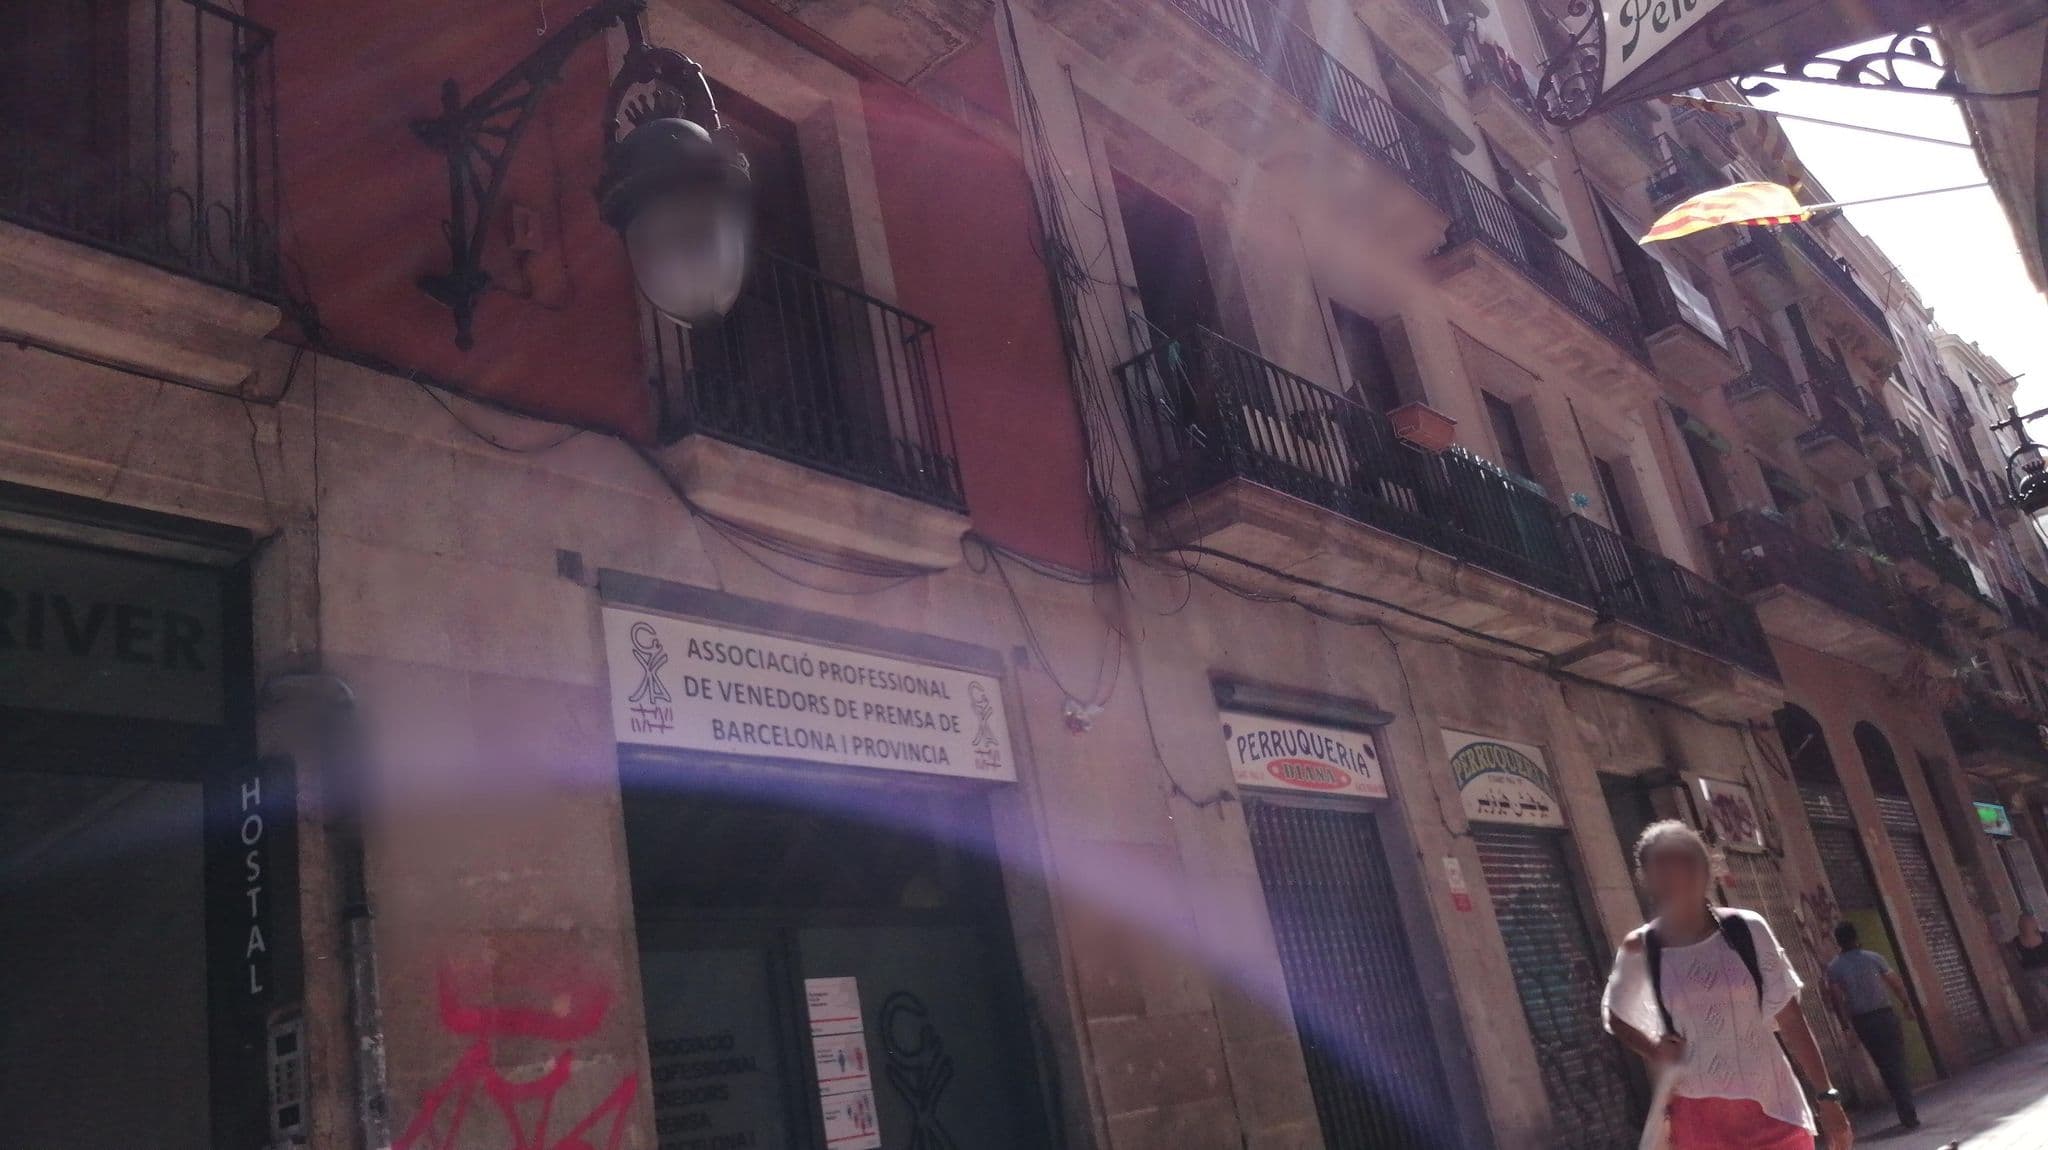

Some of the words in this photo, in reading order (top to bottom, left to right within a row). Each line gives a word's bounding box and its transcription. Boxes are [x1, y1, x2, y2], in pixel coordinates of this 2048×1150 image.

[687, 637, 815, 679] ASSOCIACIÓ
[819, 660, 951, 701] PROFESSIONAL
[684, 675, 713, 700] DE
[718, 680, 831, 717] VENEDORS
[834, 698, 860, 720] DE
[864, 702, 935, 731] PREMSA
[940, 712, 962, 734] DE
[712, 718, 837, 753] BARCELONA
[853, 739, 951, 767] PROVINCIA
[1237, 728, 1371, 779] PERRUQUERIA
[1453, 744, 1554, 796] PERRUQUER
[240, 777, 267, 996] HOSTAL
